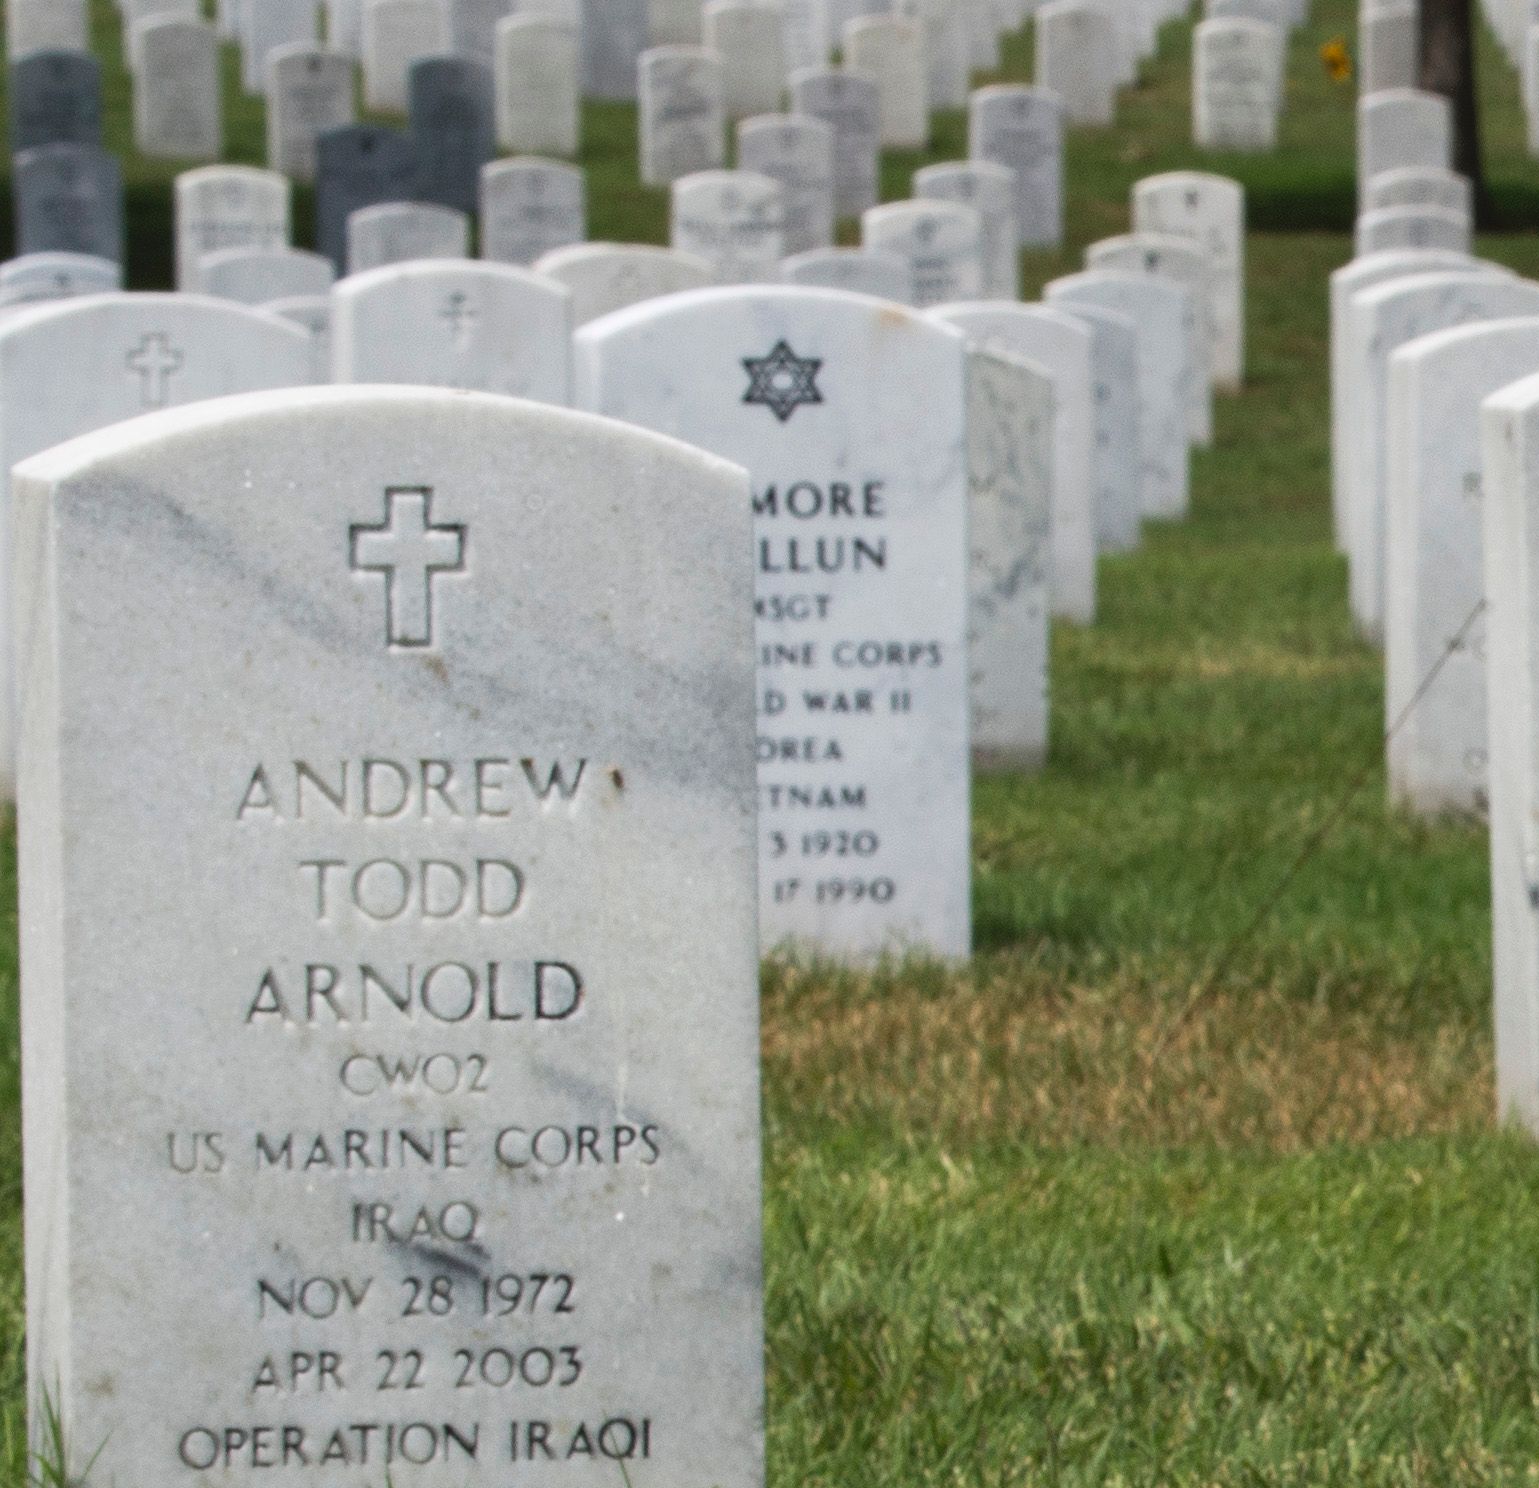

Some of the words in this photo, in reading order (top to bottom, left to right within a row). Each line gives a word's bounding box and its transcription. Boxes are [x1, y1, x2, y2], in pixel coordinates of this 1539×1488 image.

[762, 641, 816, 668] INE
[832, 640, 943, 668] CORPS
[802, 688, 873, 715] WAR
[756, 736, 843, 764] OREA
[236, 757, 588, 820] ANDREW
[768, 783, 866, 810] TNAM
[299, 857, 526, 921] TODD
[244, 960, 586, 1025] ARNOLD
[339, 1054, 488, 1096] CWO2
[166, 1131, 223, 1173] US
[256, 1127, 466, 1172] MARINE
[494, 1126, 661, 1170] CORPS
[351, 1200, 479, 1245] IRAQ
[256, 1278, 374, 1319] NOV
[401, 1277, 454, 1317] 28
[480, 1273, 576, 1316] 1972
[252, 1351, 345, 1394] APR
[376, 1351, 426, 1392] 22
[454, 1346, 584, 1389] 2003
[179, 1422, 481, 1470] OPERATION
[511, 1417, 651, 1464] IRAQI
